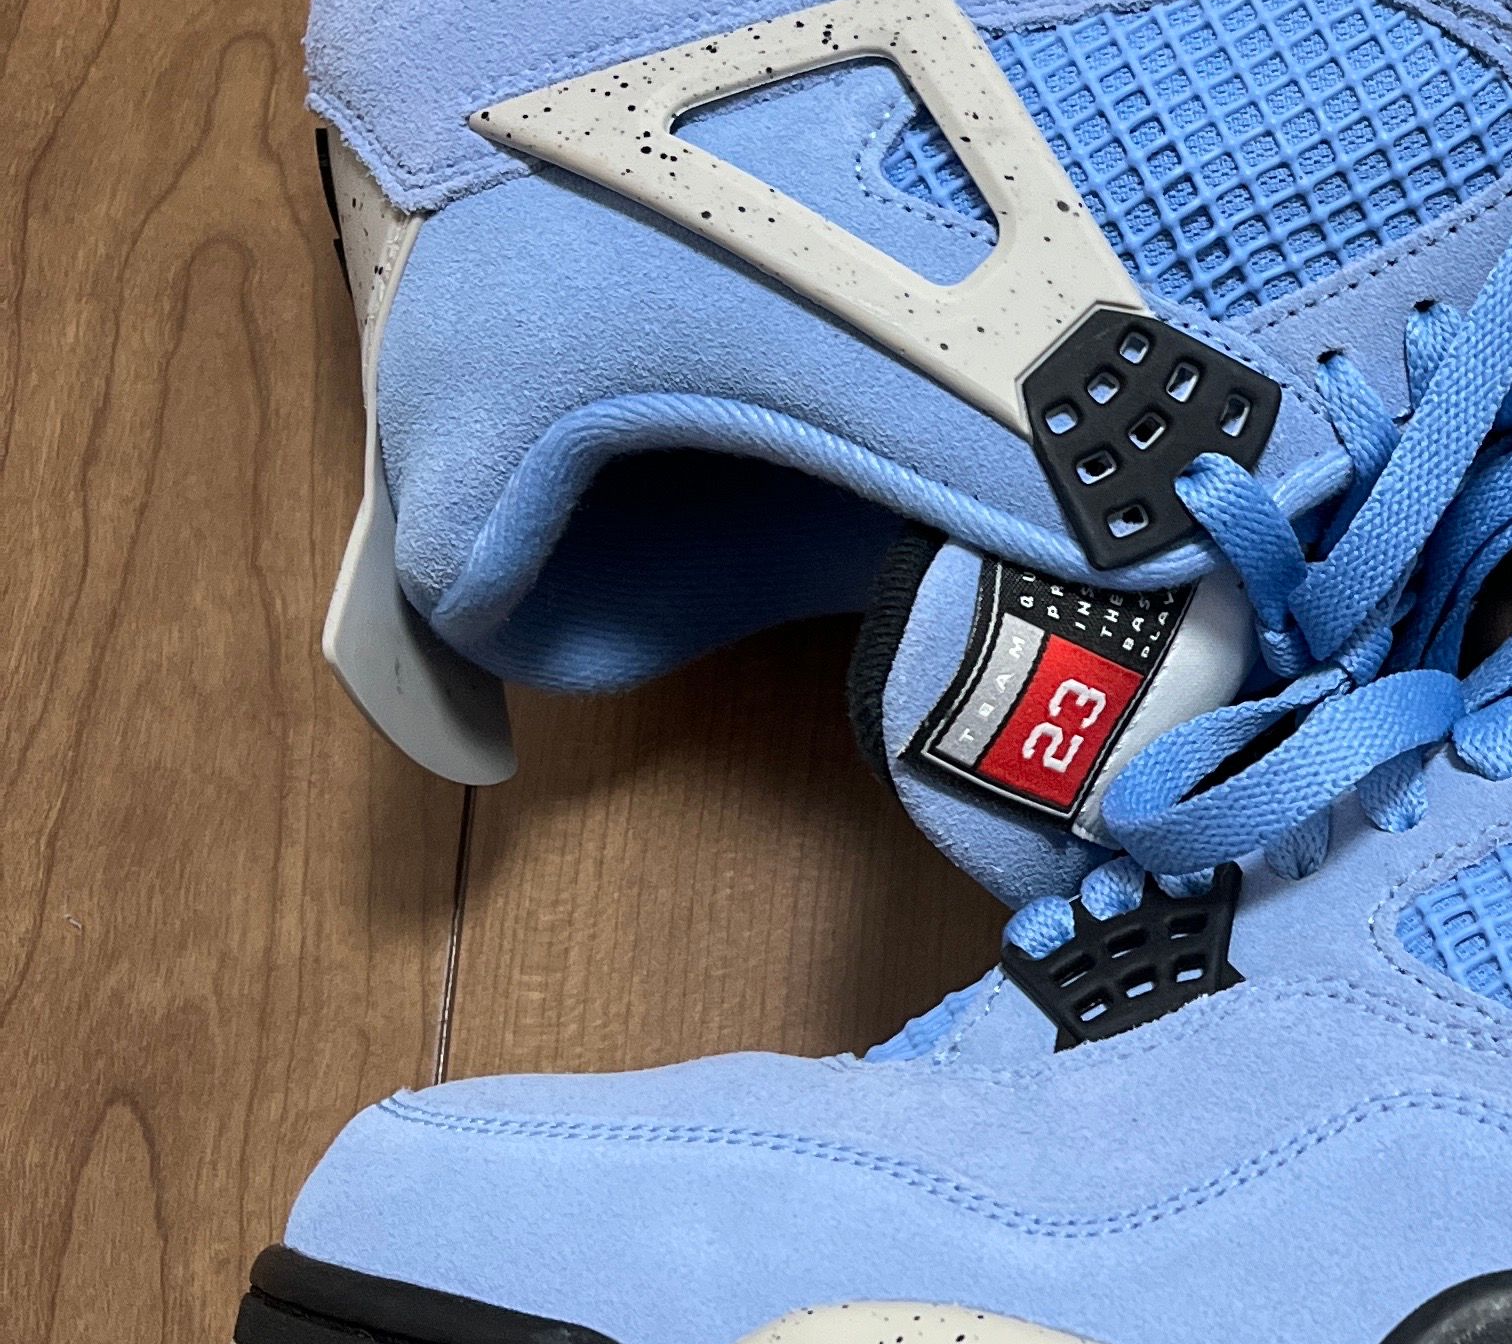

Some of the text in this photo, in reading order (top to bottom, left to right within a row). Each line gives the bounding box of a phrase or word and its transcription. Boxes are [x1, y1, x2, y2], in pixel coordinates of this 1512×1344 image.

[1100, 594, 1123, 638] THE
[958, 635, 1025, 742] TEAM
[1021, 678, 1106, 773] 23
